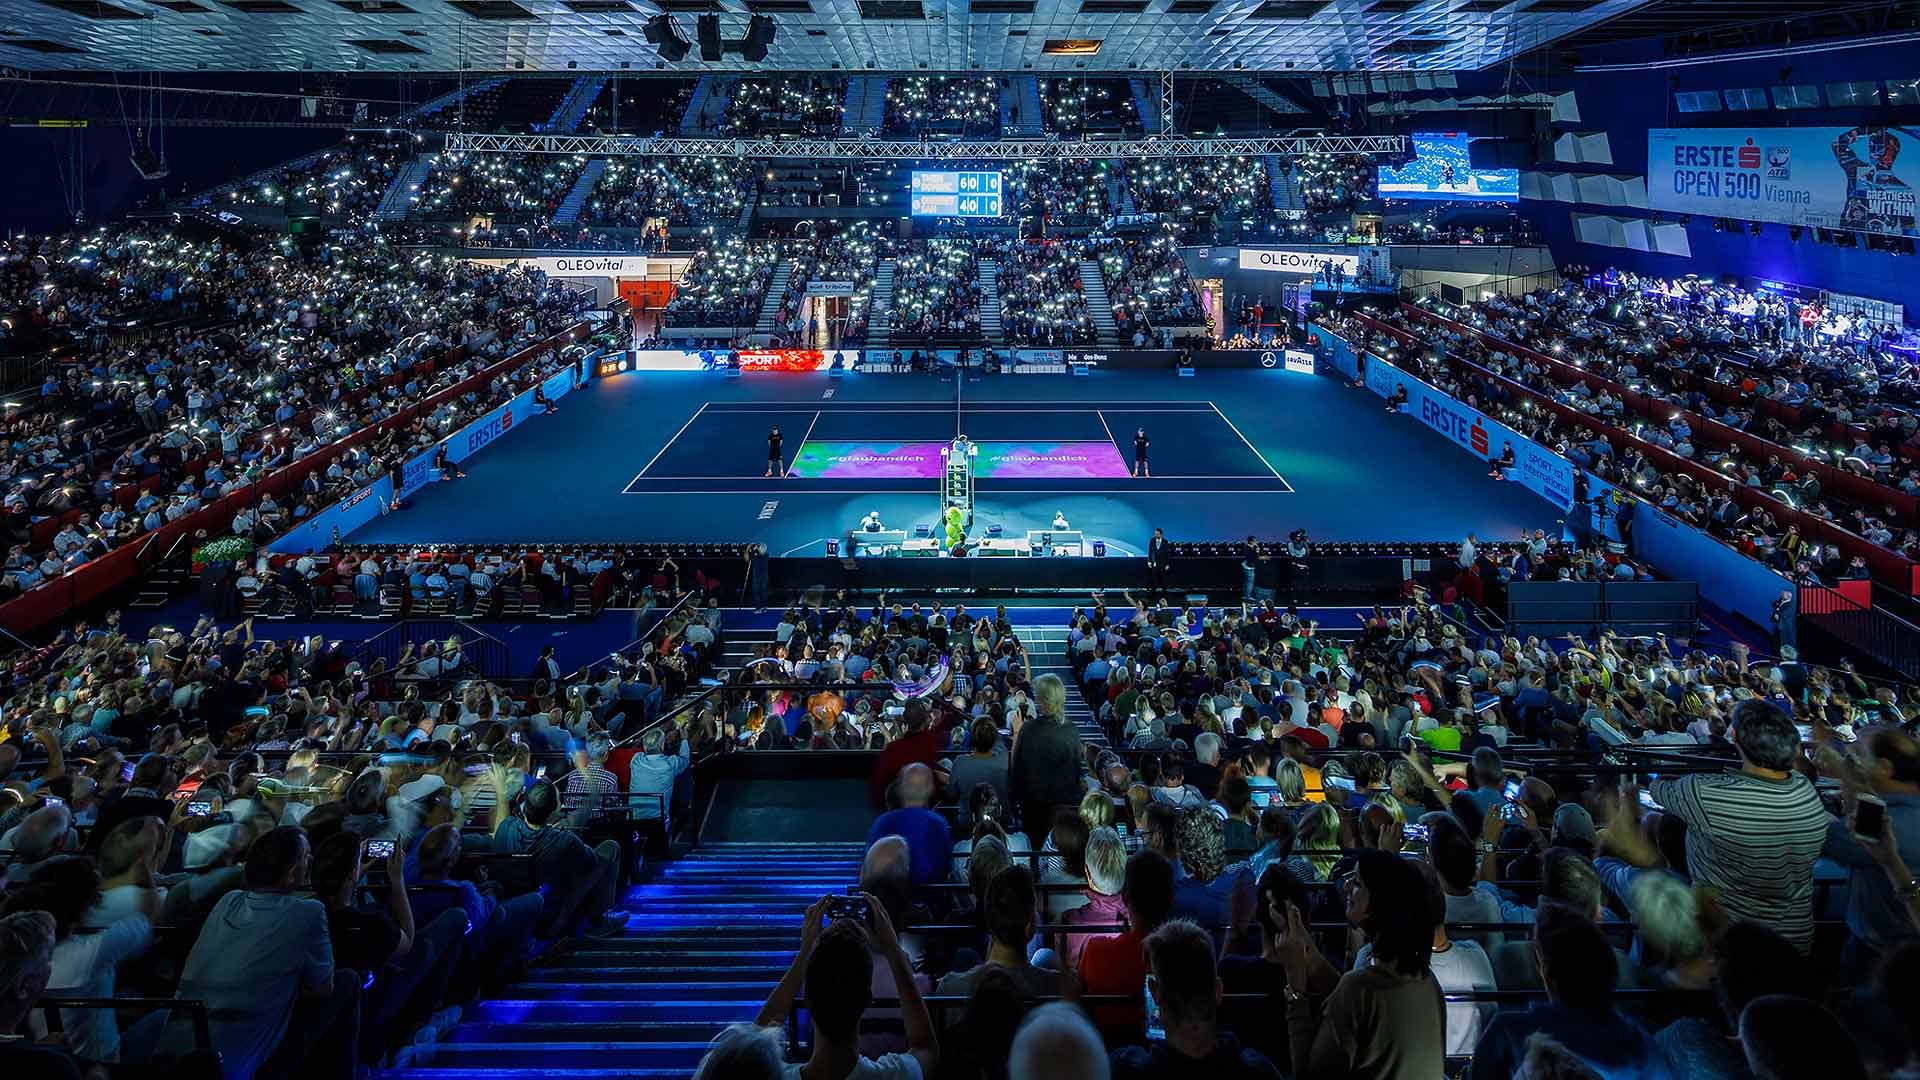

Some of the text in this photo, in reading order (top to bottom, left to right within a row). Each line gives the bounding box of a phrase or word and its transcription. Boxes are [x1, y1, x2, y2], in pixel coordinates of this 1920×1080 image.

[1674, 145, 1735, 168] ERSTE
[1767, 168, 1788, 177] ATP
[960, 177, 967, 190] 6
[969, 177, 977, 190] 0
[990, 178, 998, 189] 0
[1673, 170, 1761, 200] OPEN 500
[1764, 183, 1811, 204] Vienna
[1866, 190, 1914, 202] GREATNESS
[959, 199, 967, 212] 4
[969, 199, 977, 211] 0
[990, 200, 998, 211] 0
[1868, 199, 1915, 216] WITHIN
[556, 258, 624, 271] OLEOvital
[739, 354, 782, 365] SPORT
[1287, 356, 1312, 366] LAVAZZA
[1421, 396, 1468, 444] ERSTE
[468, 423, 501, 452] ERSTE
[827, 455, 925, 463] #glaubandich
[991, 455, 1089, 463] #glaubandich
[1528, 452, 1553, 474] SPORT
[1523, 463, 1570, 496] international
